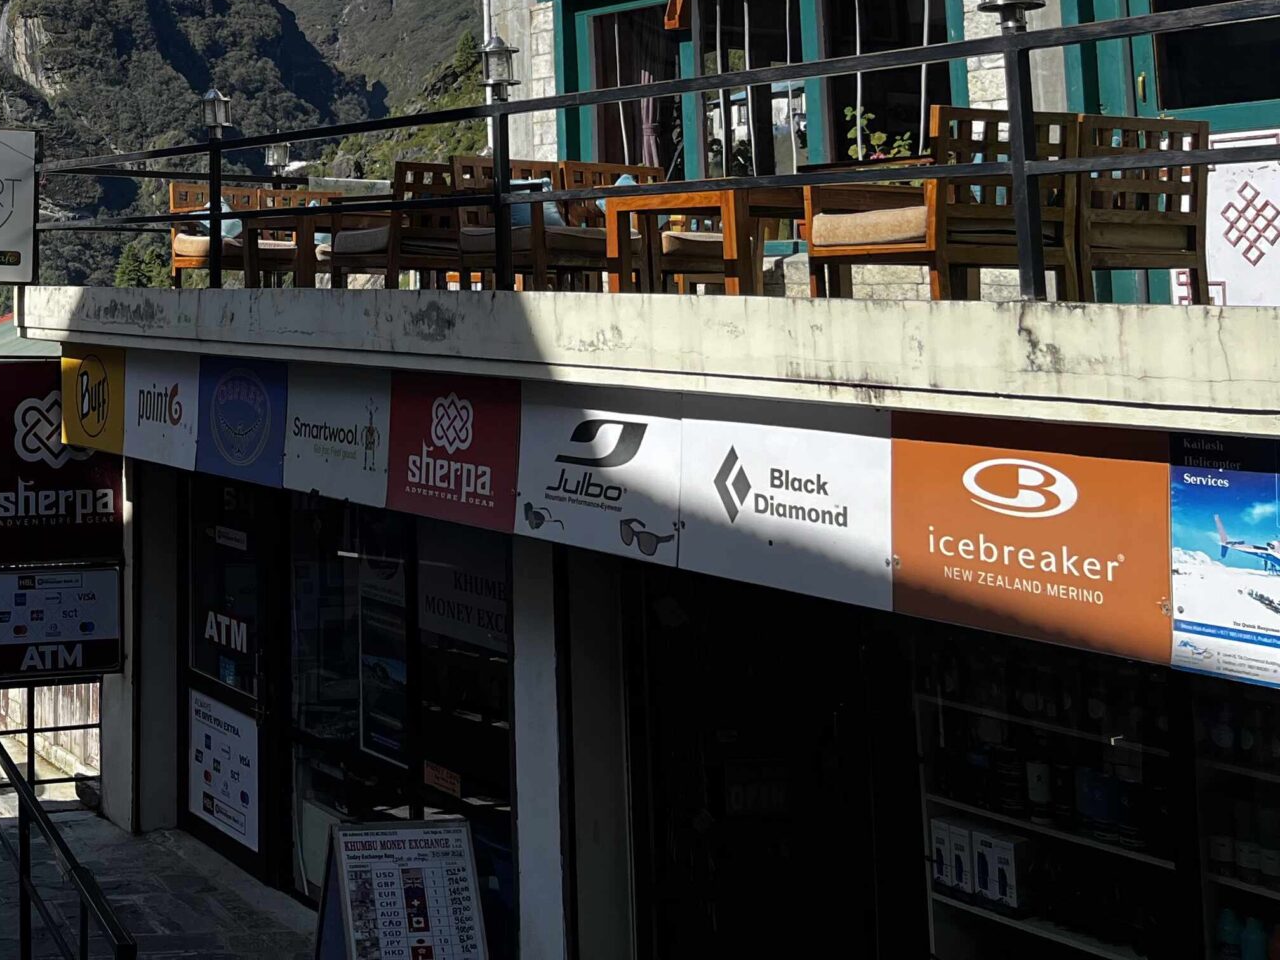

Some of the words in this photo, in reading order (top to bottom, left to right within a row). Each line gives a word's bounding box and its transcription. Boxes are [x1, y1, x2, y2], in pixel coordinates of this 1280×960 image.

[1183, 438, 1224, 452] Kailash
[407, 439, 491, 503] sherpa
[1184, 455, 1241, 472] Helicopter
[546, 469, 622, 501] Julbo
[770, 467, 829, 496] Black
[1183, 473, 1229, 488] Services
[405, 485, 458, 501] ADVENTURE
[468, 497, 494, 508] GEAR
[86, 515, 114, 524] GEAR
[754, 492, 848, 528] Diamond
[928, 525, 1119, 582] icebreaker
[77, 592, 96, 601] VISA
[944, 566, 972, 582] NEW
[978, 572, 1042, 594] ZEALAND
[1047, 583, 1104, 605] MERINO
[62, 608, 78, 618] sct
[425, 594, 472, 624] MONEY
[204, 610, 247, 654] ATM
[20, 642, 83, 671] ATM
[239, 754, 250, 768] VISA
[344, 840, 378, 851] KHUMBU
[379, 839, 407, 850] MONEY
[409, 838, 450, 849] EXCHANGE
